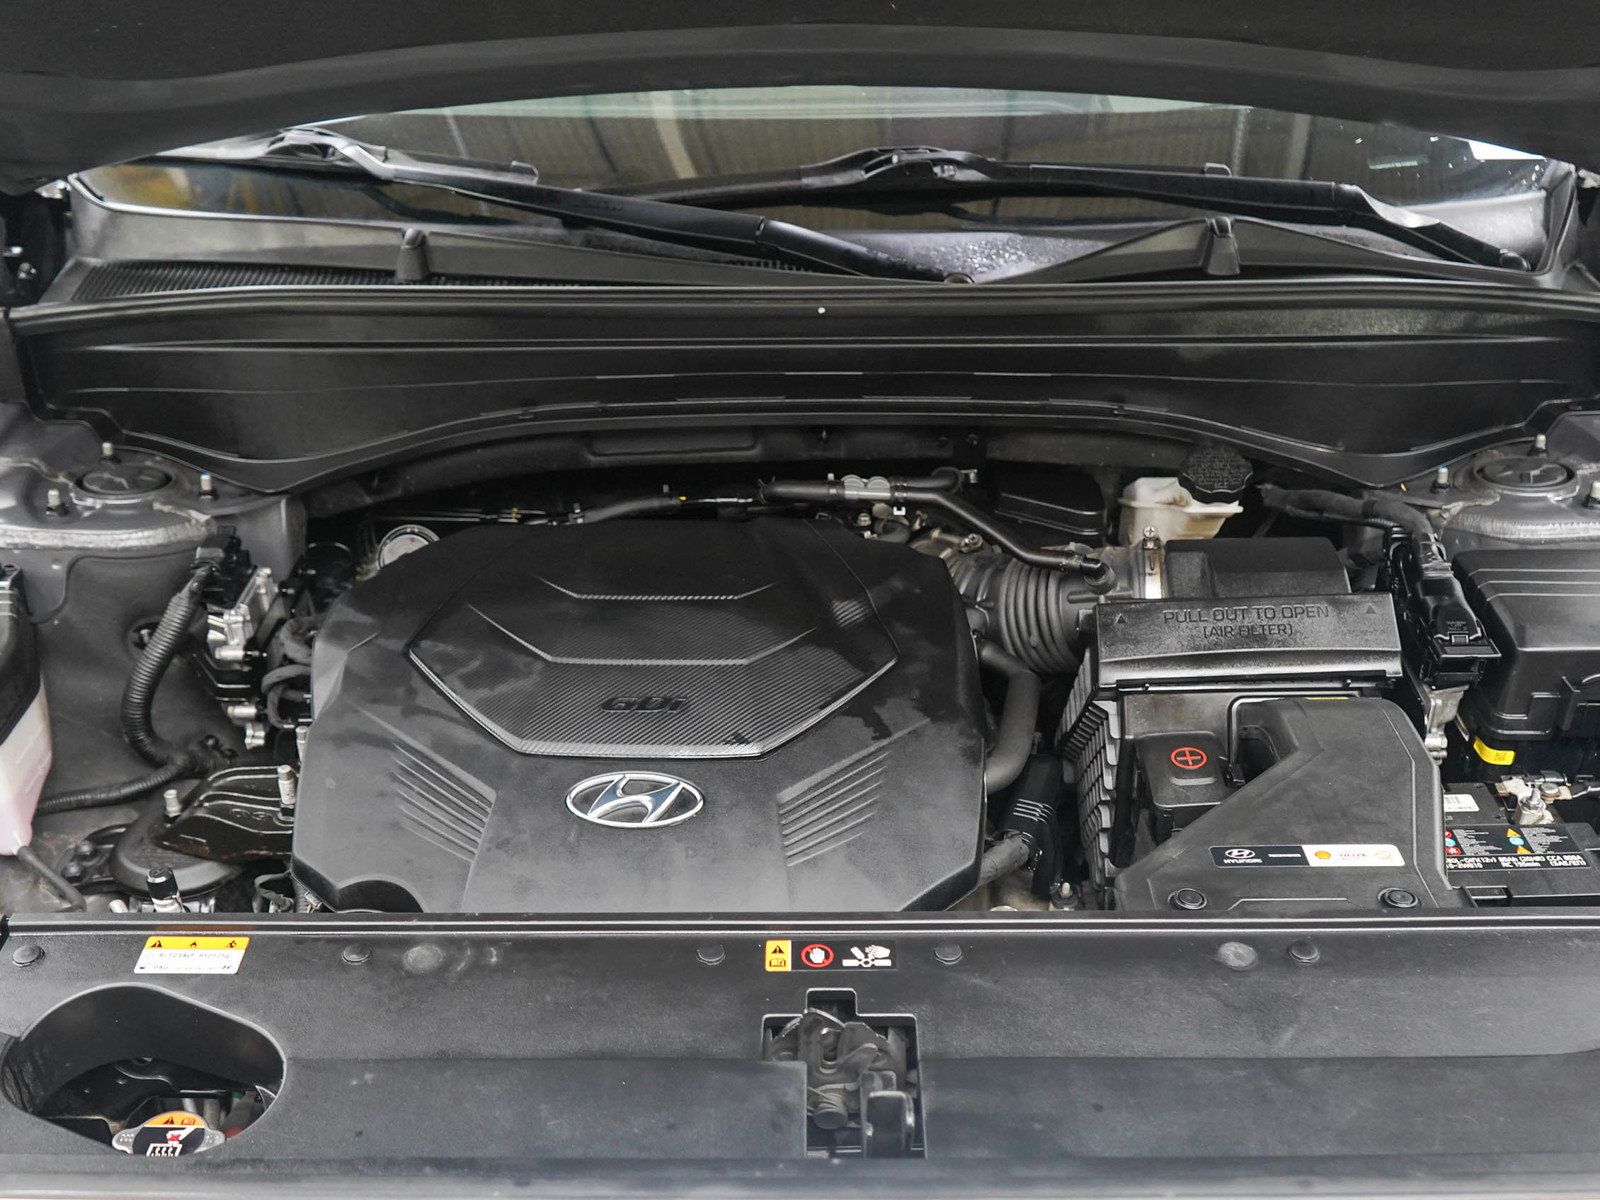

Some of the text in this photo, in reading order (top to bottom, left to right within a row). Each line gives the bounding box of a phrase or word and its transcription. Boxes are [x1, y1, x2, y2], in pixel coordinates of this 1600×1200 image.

[1163, 603, 1330, 624] PULL OUT TO OPEN
[1238, 622, 1294, 638] FILTER)
